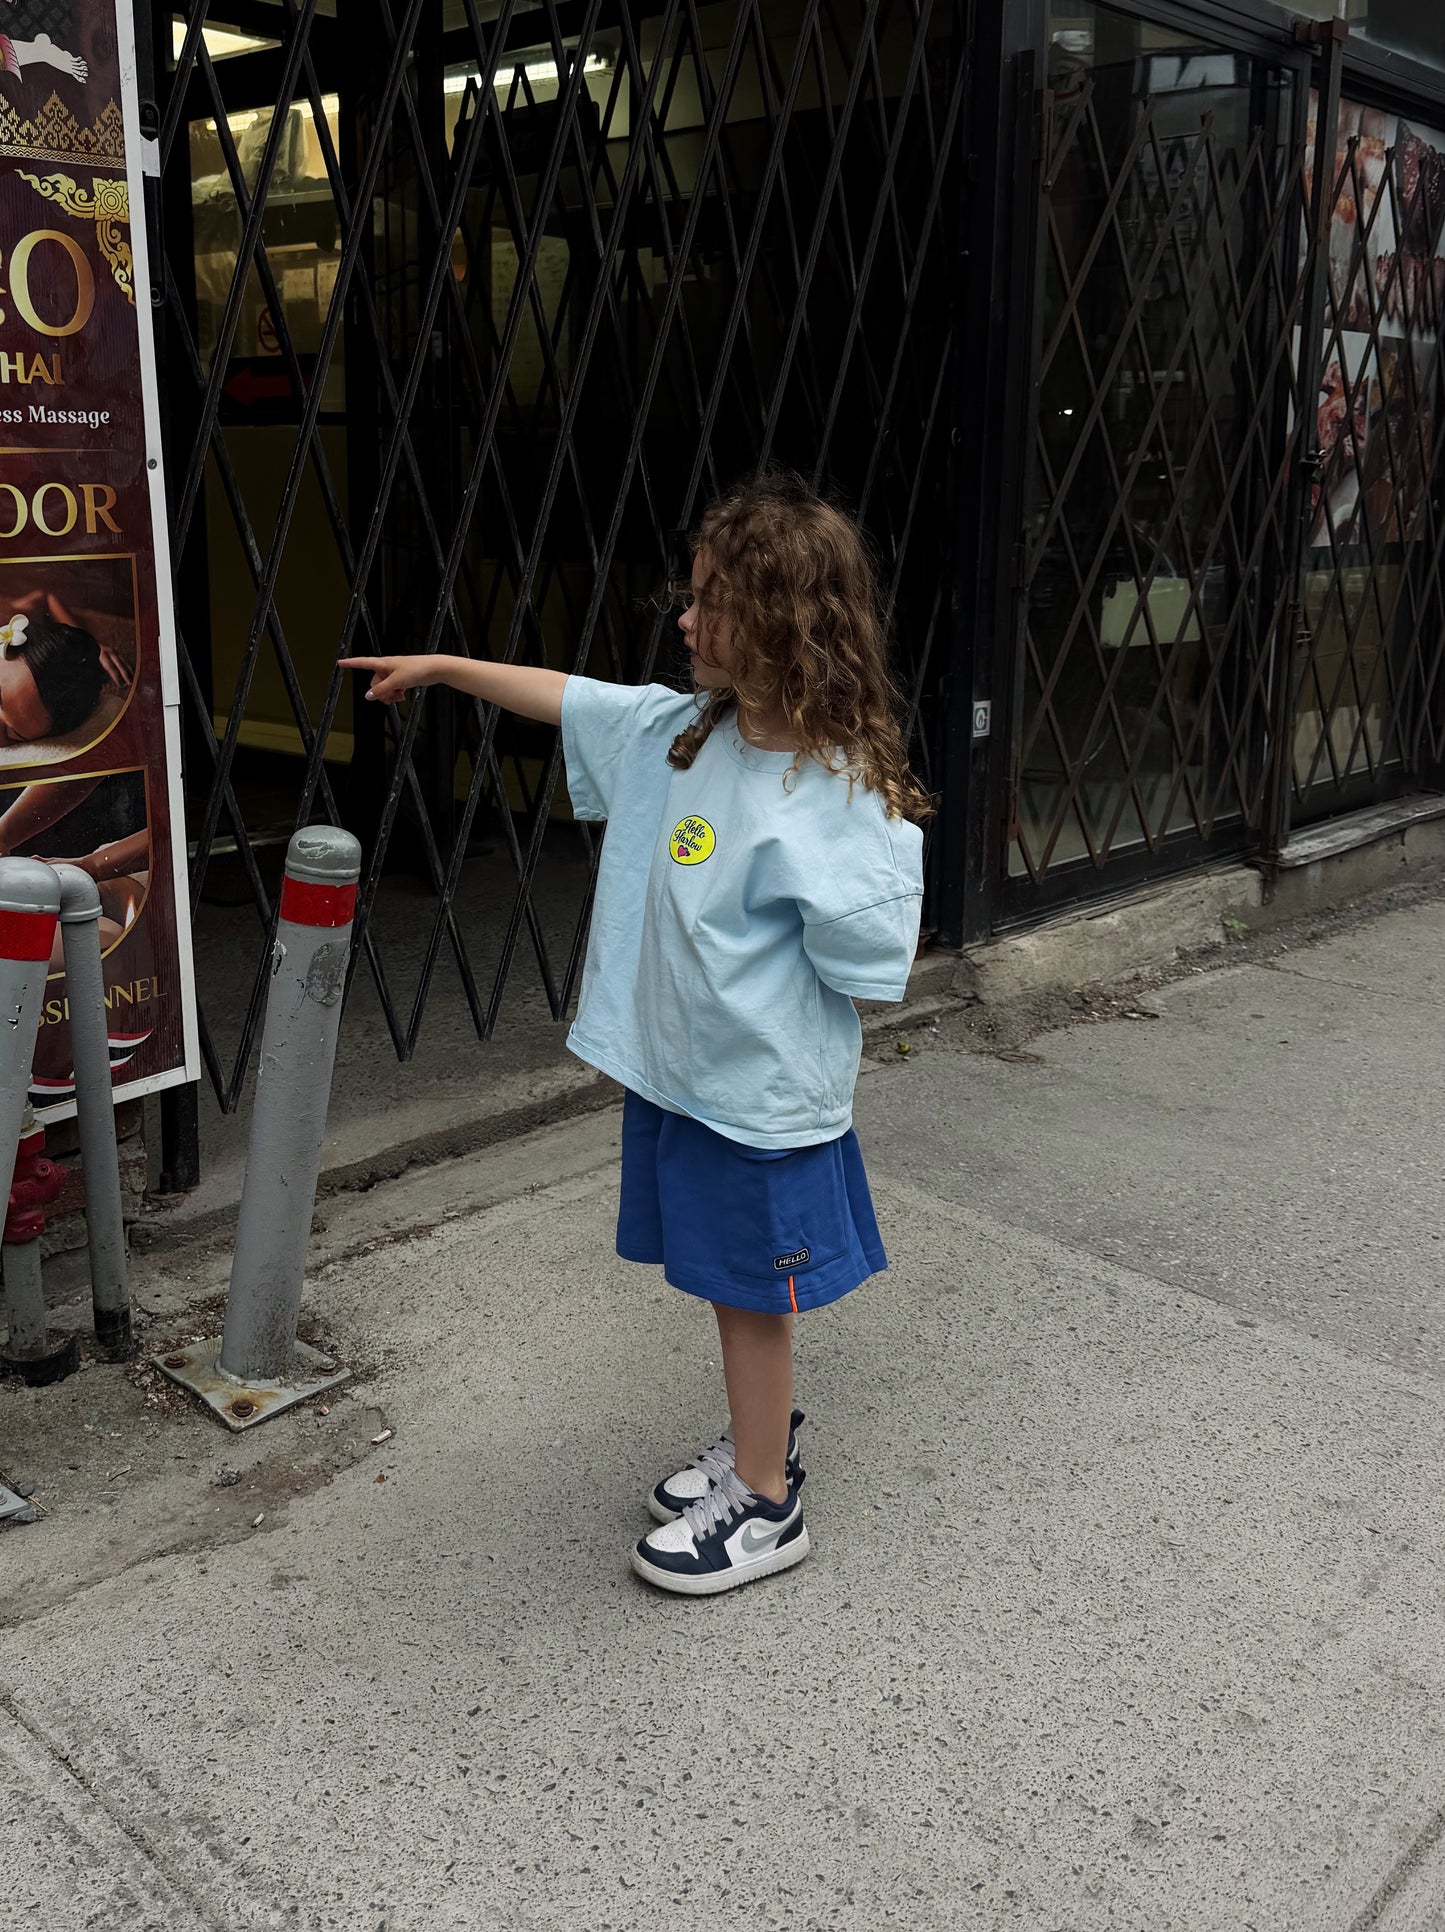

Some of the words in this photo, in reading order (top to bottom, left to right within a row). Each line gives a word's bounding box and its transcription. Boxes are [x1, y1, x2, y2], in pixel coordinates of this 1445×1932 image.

[0, 409, 23, 423] ss
[28, 405, 110, 429] Massage
[683, 819, 706, 838] Hello
[779, 1252, 806, 1266] HELLO
